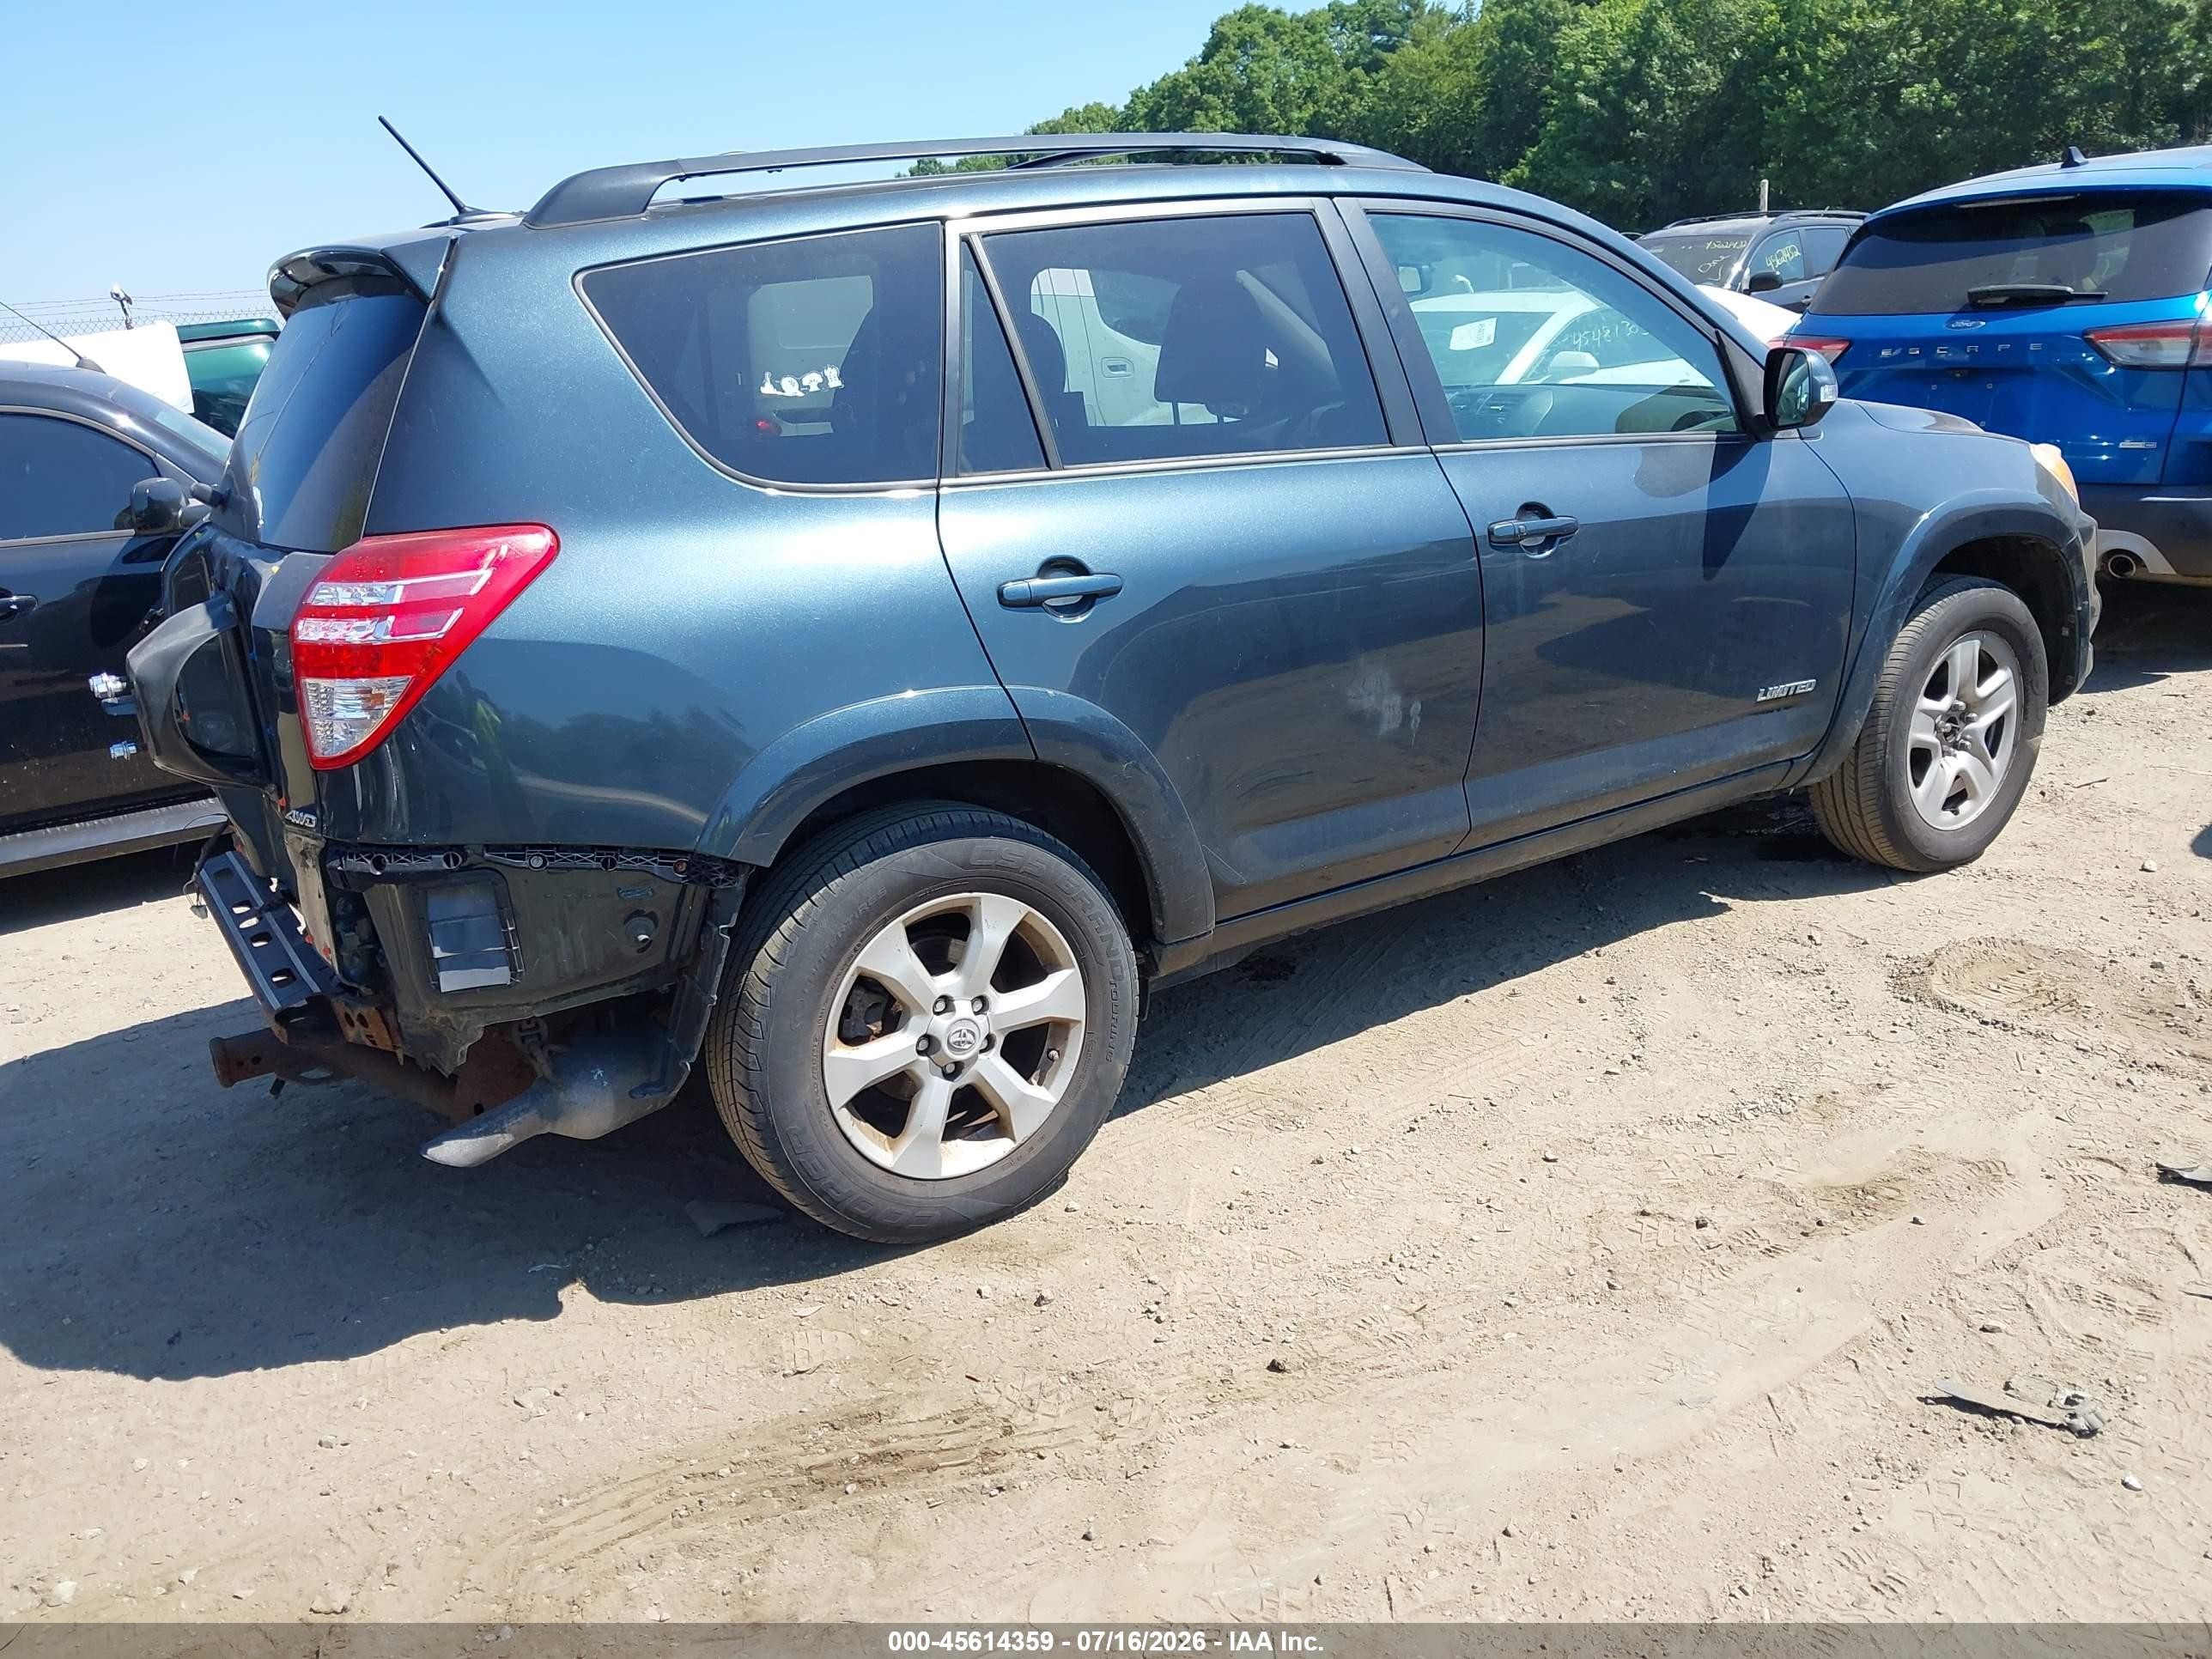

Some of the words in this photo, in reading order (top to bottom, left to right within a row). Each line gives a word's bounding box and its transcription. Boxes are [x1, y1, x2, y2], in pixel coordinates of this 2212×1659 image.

[1881, 343, 2043, 356] ESCAPE
[1756, 678, 1817, 702] LIMITED
[284, 810, 317, 828] 4WD
[1054, 868, 1125, 981] GRAND
[1105, 979, 1121, 1062] TOURING
[786, 1126, 942, 1230] COOPER
